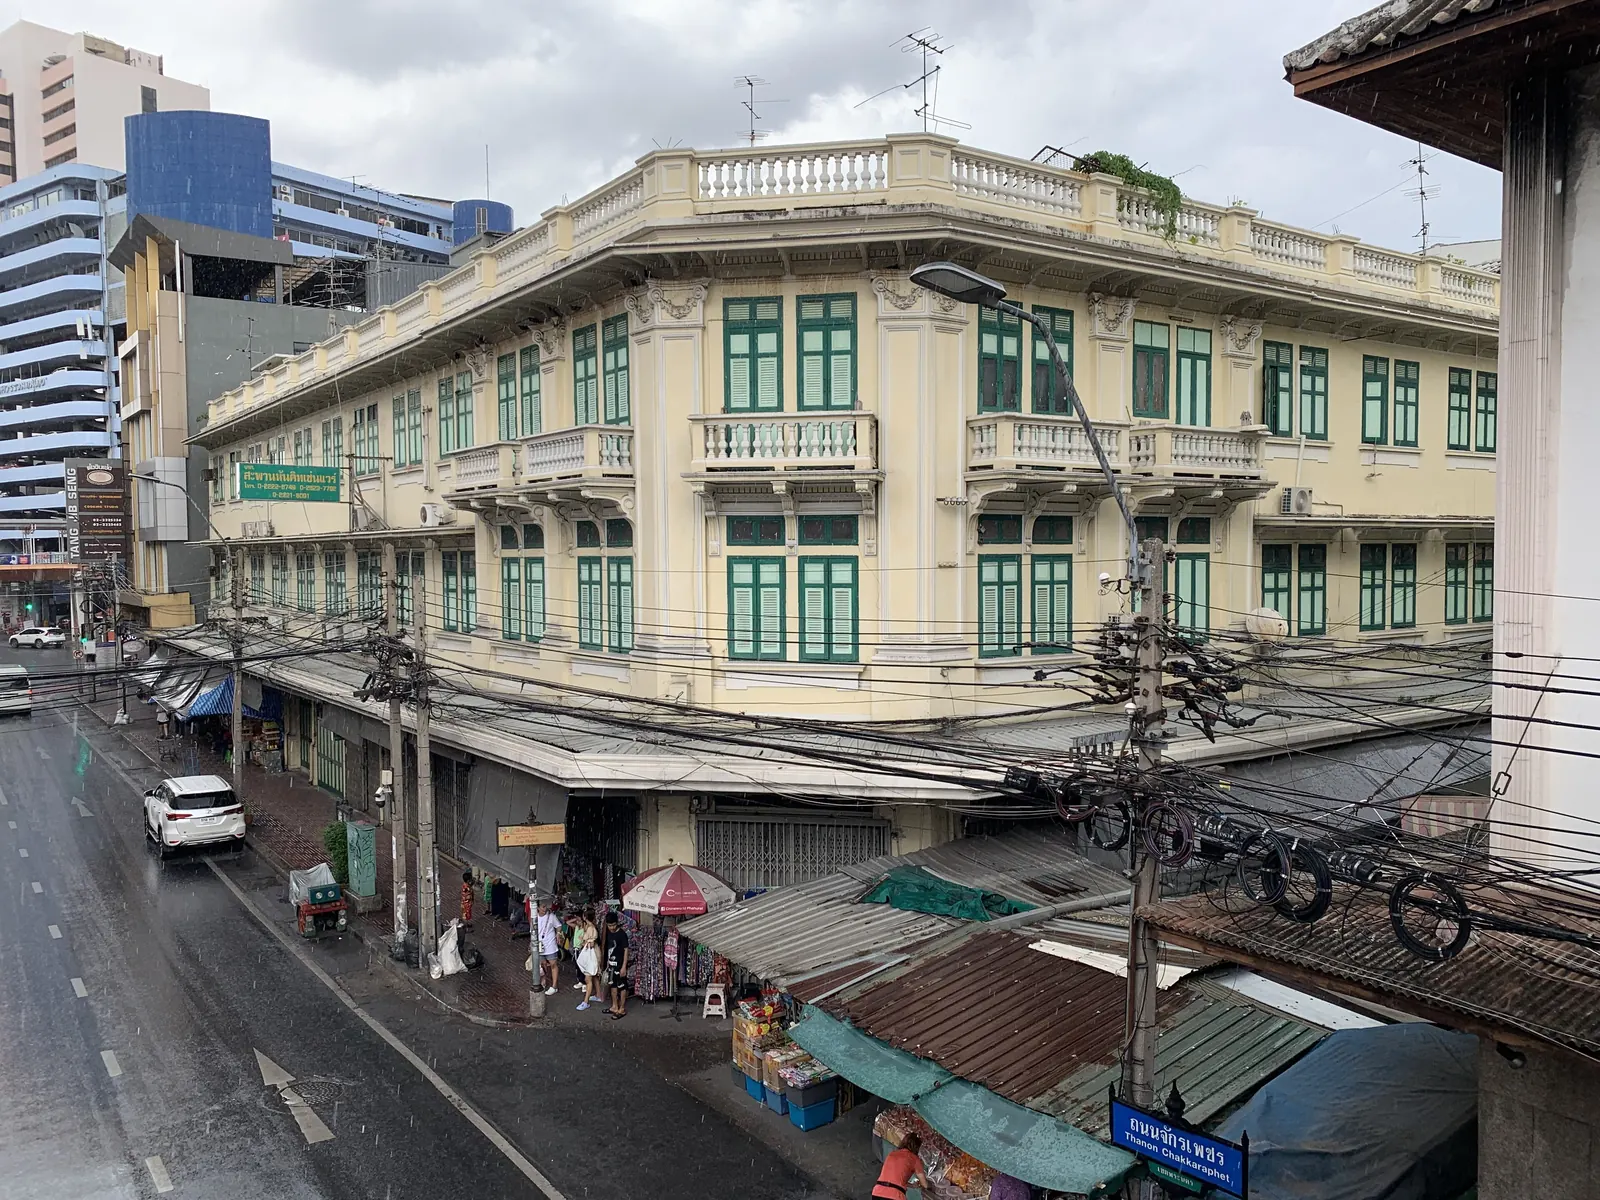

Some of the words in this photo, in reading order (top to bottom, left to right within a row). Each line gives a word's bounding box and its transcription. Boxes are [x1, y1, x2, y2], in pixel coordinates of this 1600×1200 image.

[67, 468, 77, 499] SENG
[69, 528, 80, 559] TANG
[1125, 1131, 1159, 1153] Thanon
[1161, 1148, 1230, 1183] Chakkaraphet
[1129, 1118, 1224, 1166] ถนนจักรเพชร
